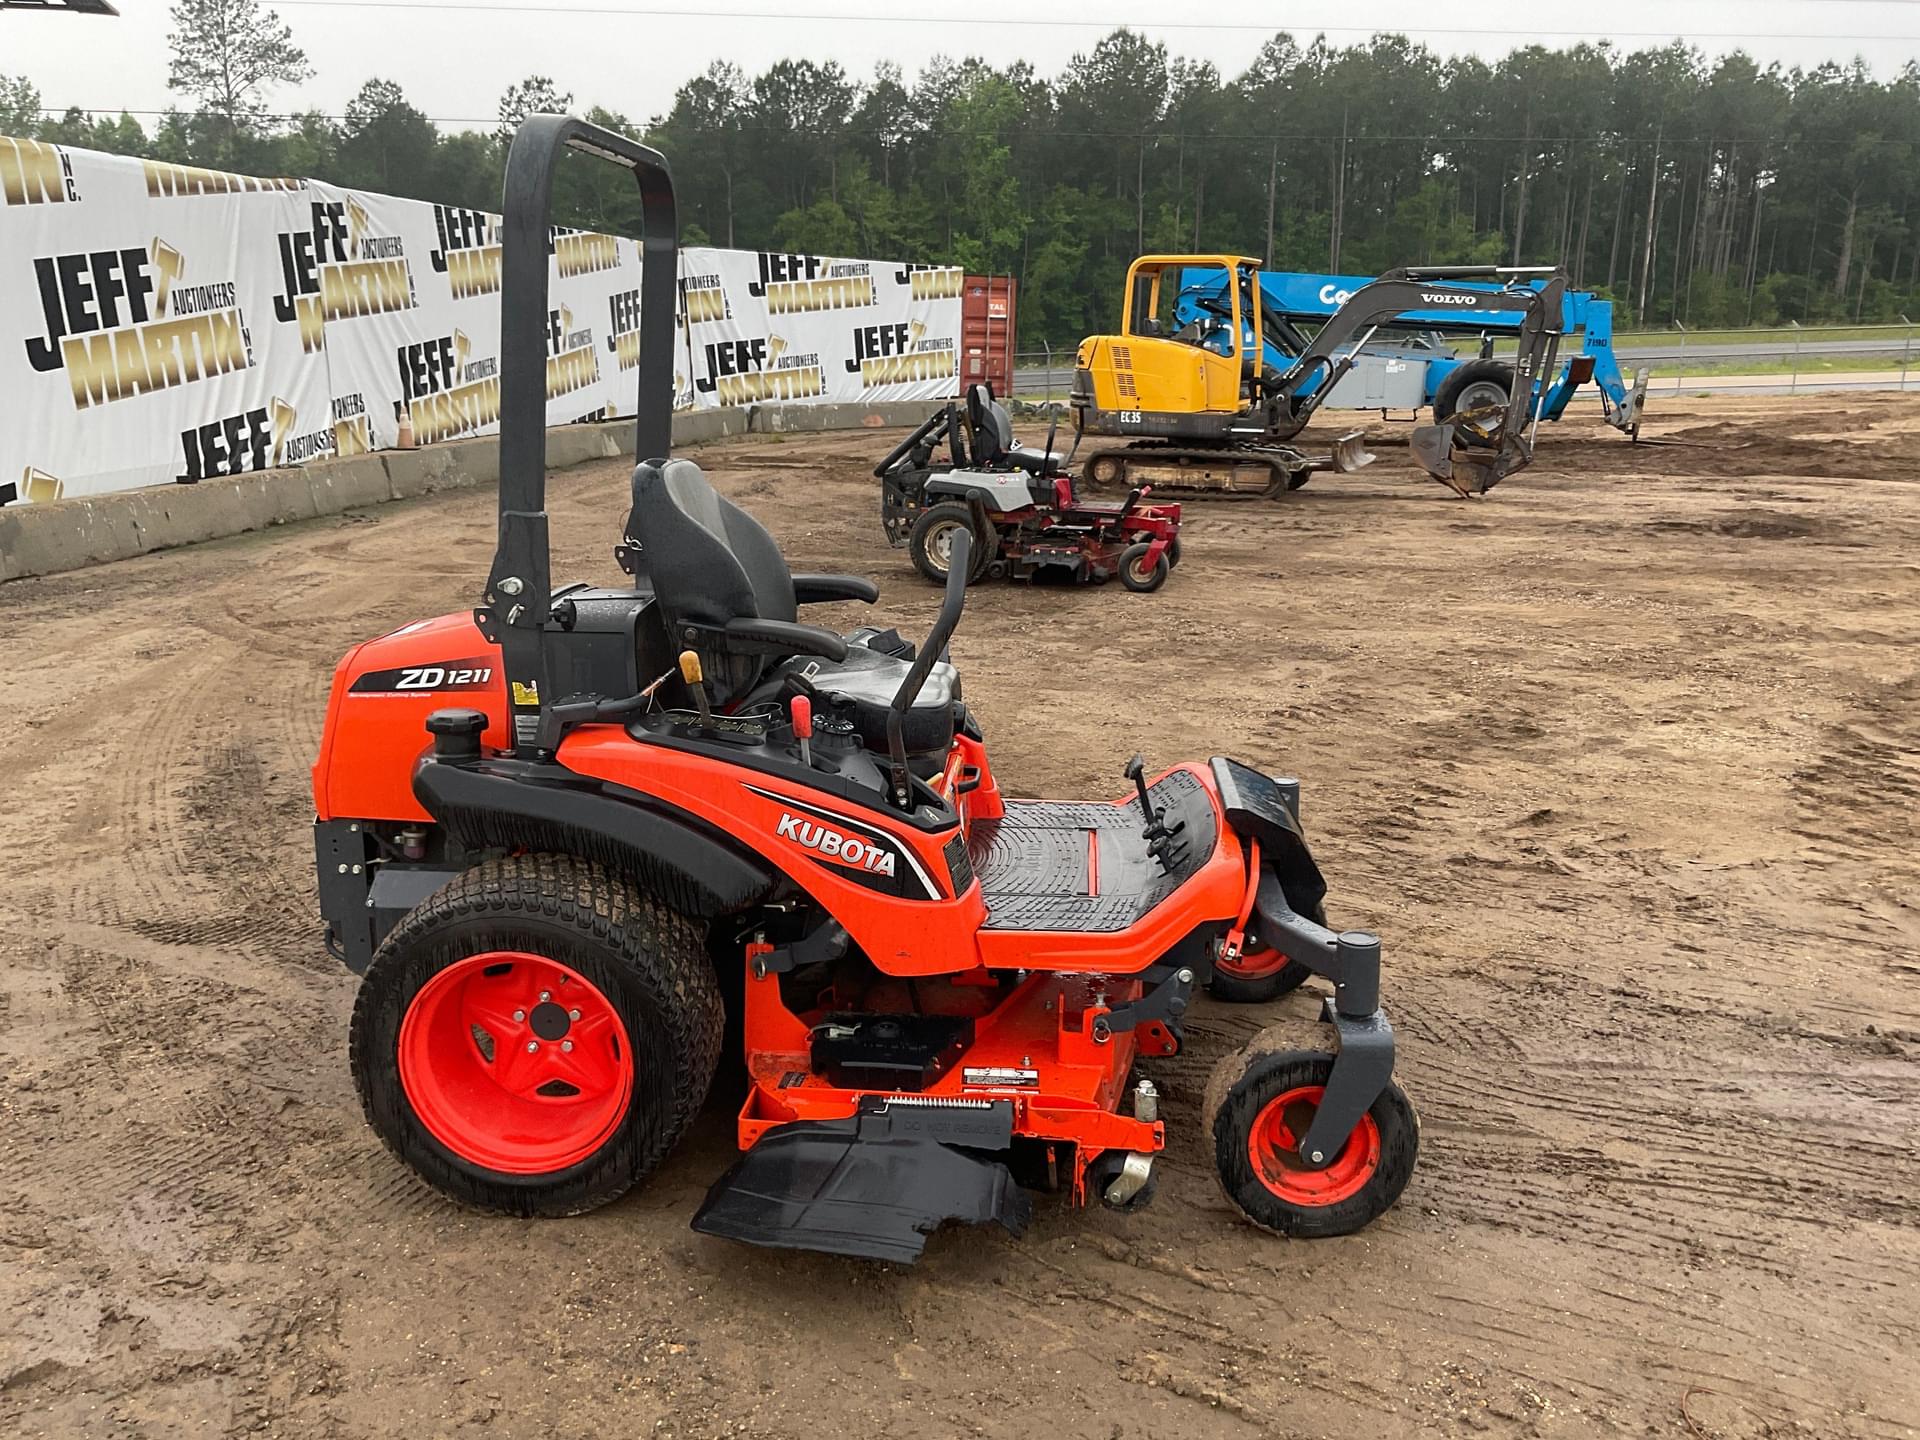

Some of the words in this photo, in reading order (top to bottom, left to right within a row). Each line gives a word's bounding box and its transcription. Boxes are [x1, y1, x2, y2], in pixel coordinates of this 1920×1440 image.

[273, 202, 349, 322] JEFF
[749, 252, 821, 297] JEFF
[831, 263, 869, 278] AUCTIONEERS
[25, 248, 153, 372] JEFF
[171, 282, 236, 316] AUCTIONEERS
[767, 277, 871, 315] MARTIN
[989, 303, 1005, 311] TAL
[1420, 293, 1477, 305] VOLVO
[607, 289, 640, 352] JEFF
[62, 310, 247, 411] MARTIN
[696, 339, 766, 392] JEFF
[778, 353, 819, 369] AUCTIONEERS
[845, 323, 909, 373] JEFF
[718, 367, 820, 407] MARTIN
[862, 350, 954, 389] MARTIN
[176, 407, 272, 485] JEFF
[395, 667, 445, 690] ZD
[447, 668, 492, 685] 1211
[775, 812, 896, 878] KUBOTA
